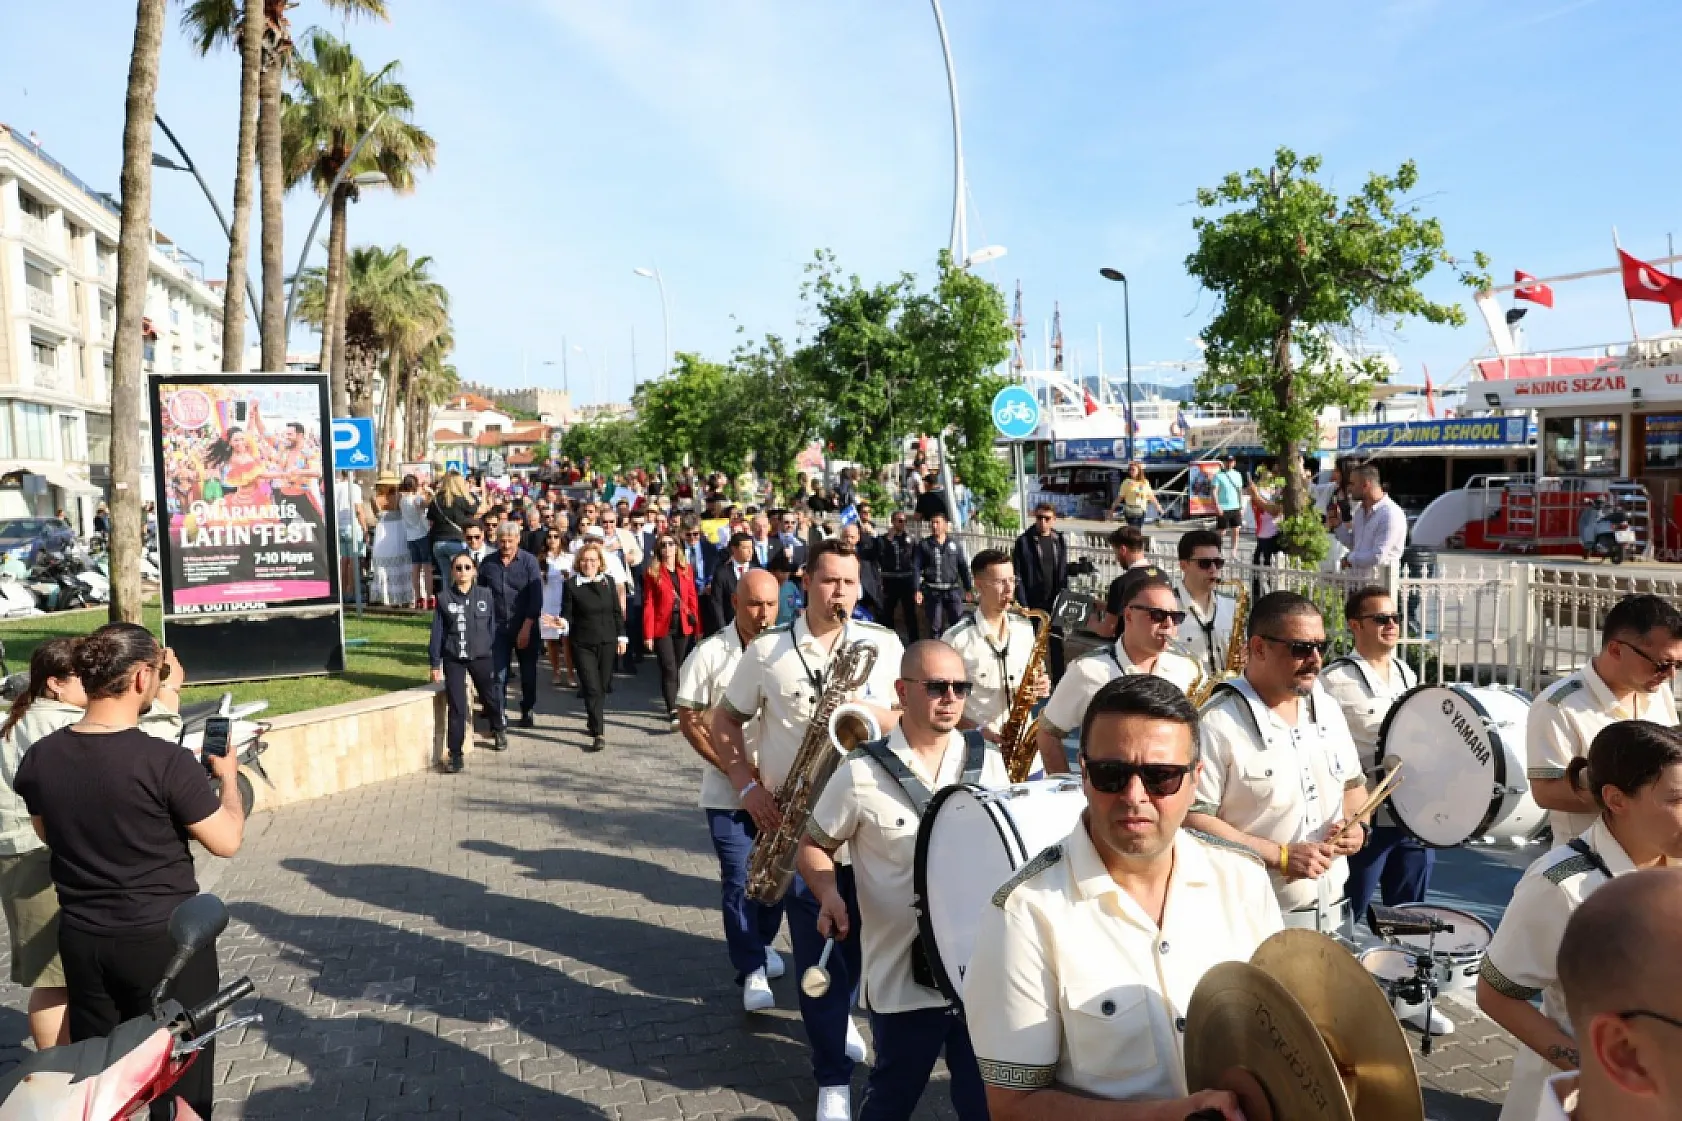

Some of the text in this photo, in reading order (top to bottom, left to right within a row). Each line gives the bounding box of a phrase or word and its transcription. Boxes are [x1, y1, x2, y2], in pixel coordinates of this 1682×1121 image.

[1531, 375, 1626, 395] KING SEZAR
[331, 422, 360, 450] P
[1442, 422, 1501, 441] SCHOOL
[252, 522, 317, 547] FEST
[254, 552, 279, 565] 7-10
[1451, 709, 1491, 767] YAMAHA
